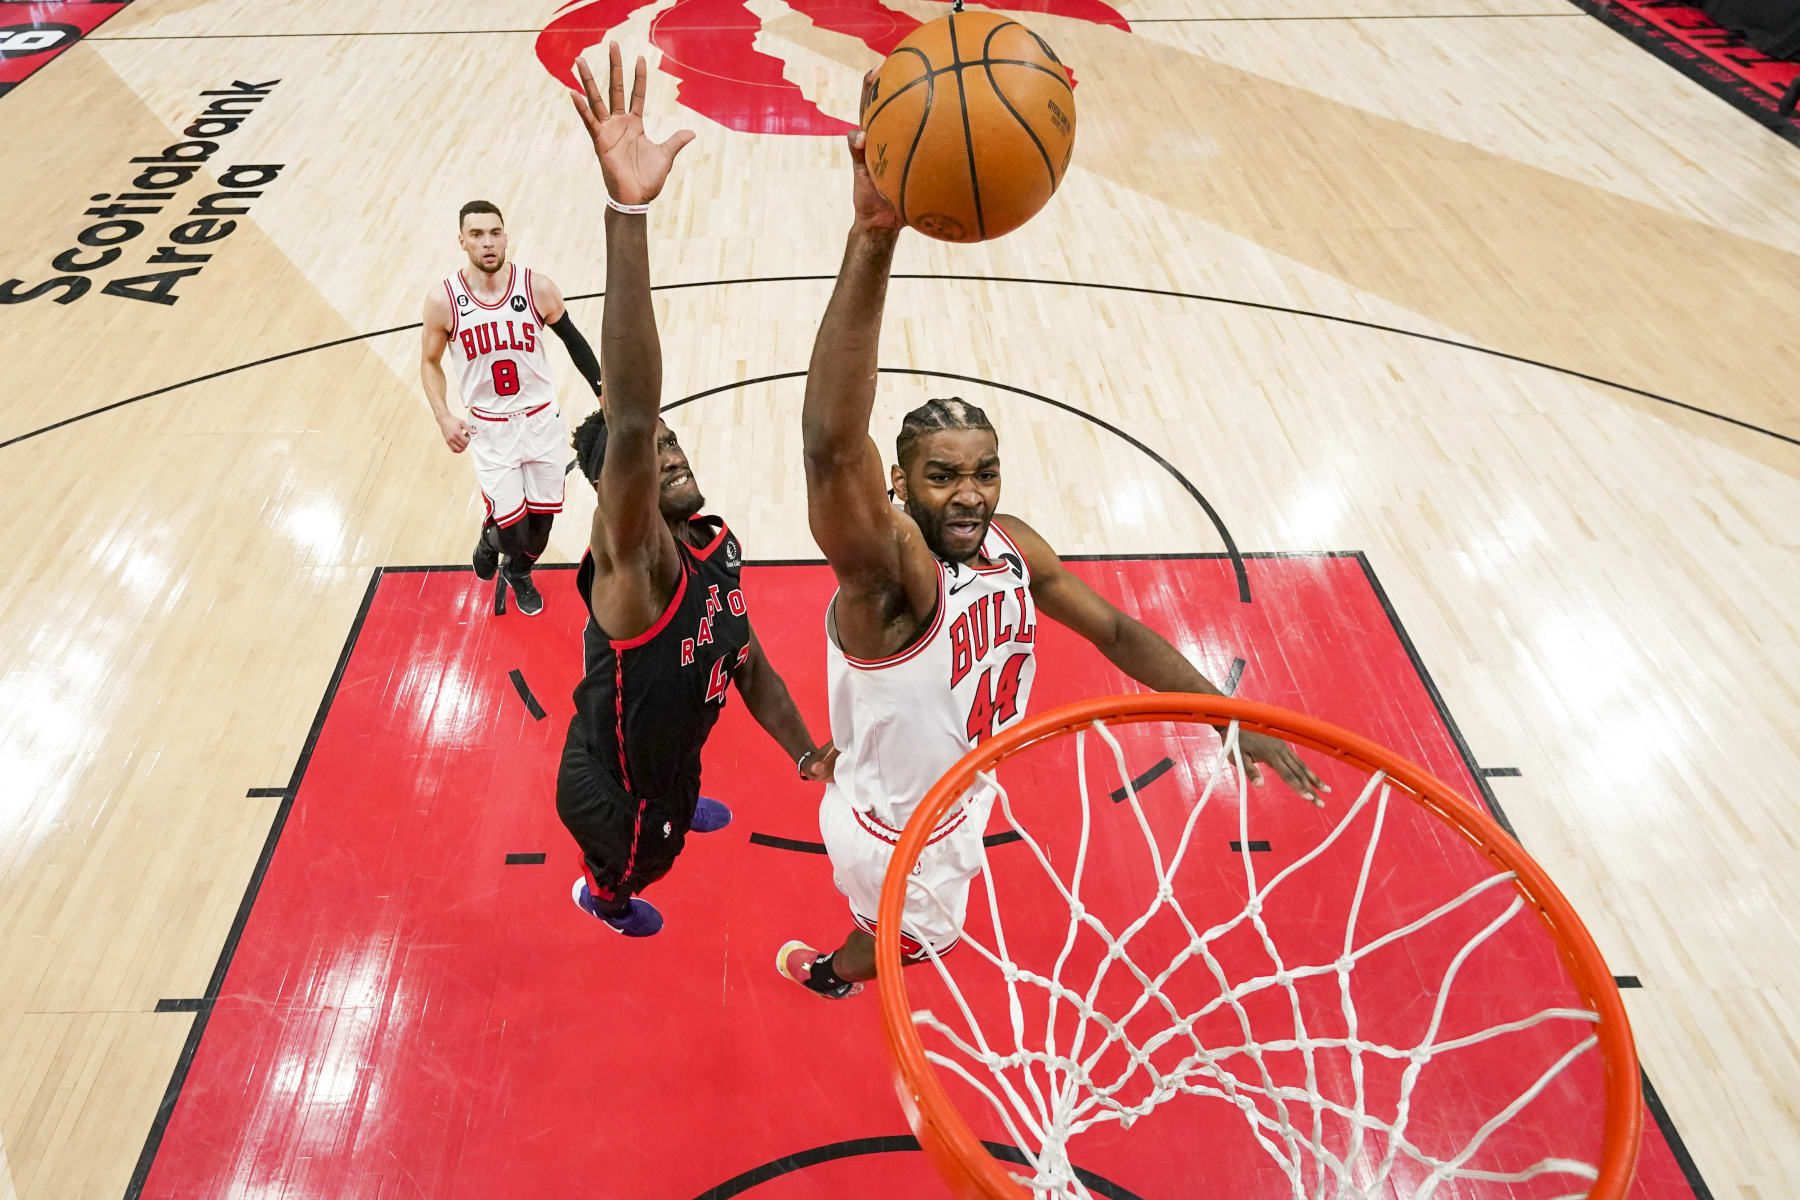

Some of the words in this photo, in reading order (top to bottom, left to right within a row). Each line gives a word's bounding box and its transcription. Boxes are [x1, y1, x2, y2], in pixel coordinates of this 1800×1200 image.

[0, 79, 282, 304] Scotiabank
[100, 164, 286, 306] Arena
[459, 320, 535, 361] BULLS
[491, 359, 520, 396] 8
[950, 586, 1036, 690] BULL
[966, 653, 1031, 747] 44
